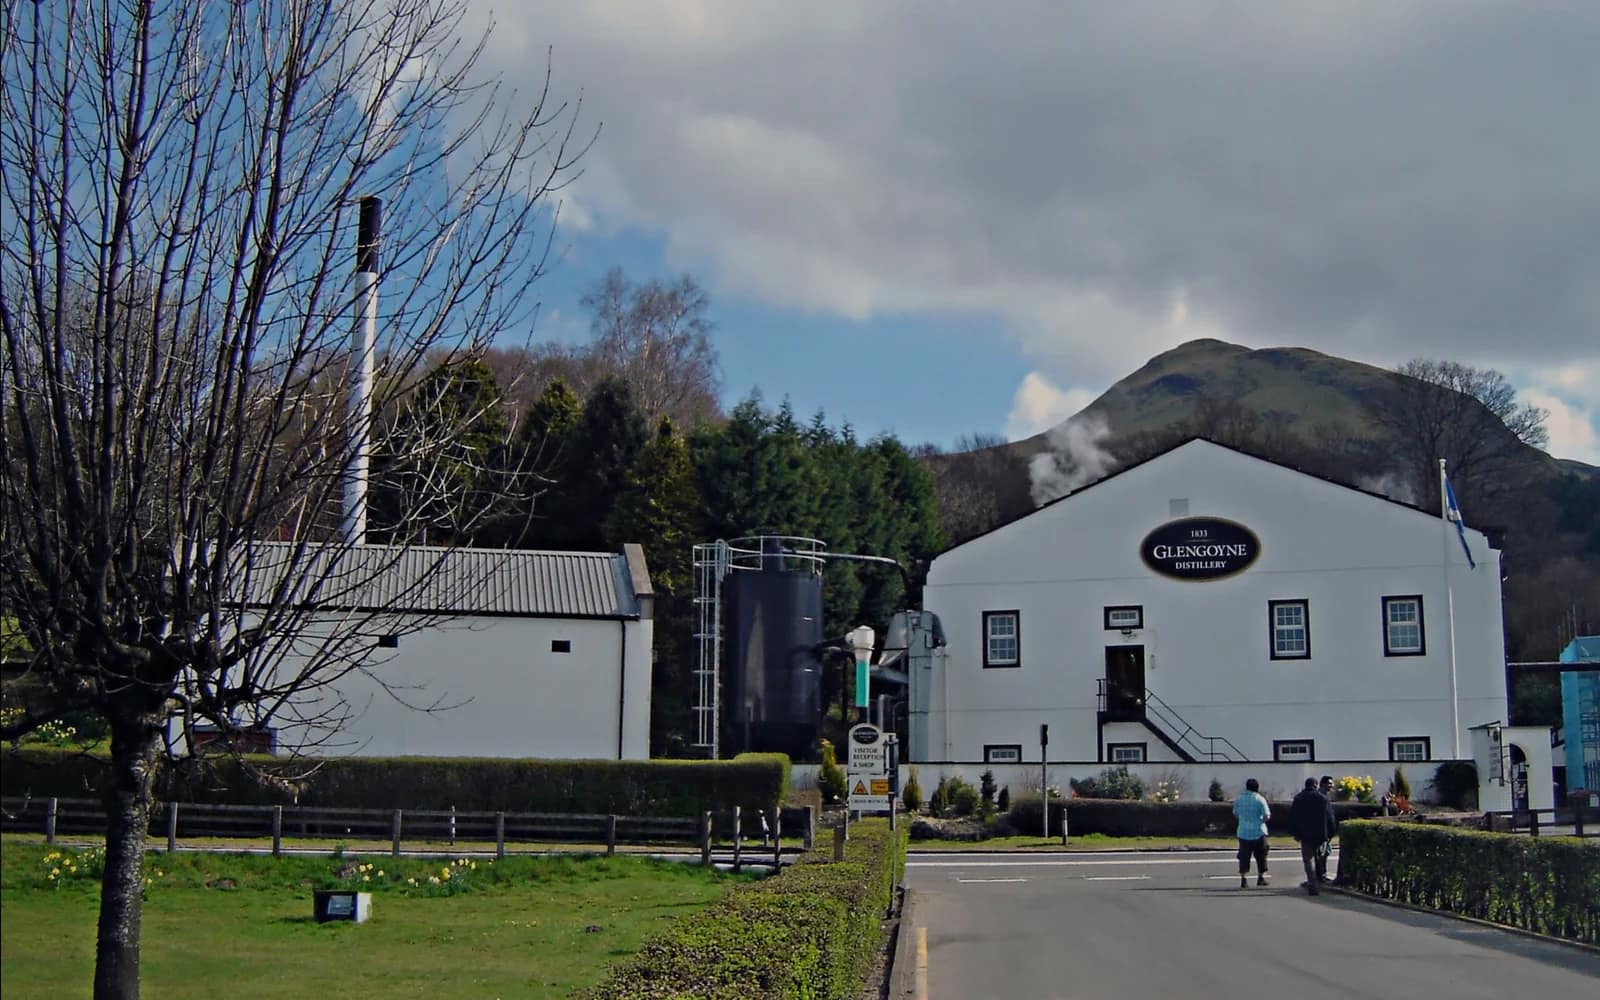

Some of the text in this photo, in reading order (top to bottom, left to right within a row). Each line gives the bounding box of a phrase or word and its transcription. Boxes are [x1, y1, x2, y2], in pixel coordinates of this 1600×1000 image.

[1191, 530, 1208, 538] 1833
[1153, 544, 1248, 559] GLENGOYNE
[1175, 561, 1227, 569] DISTILLERY
